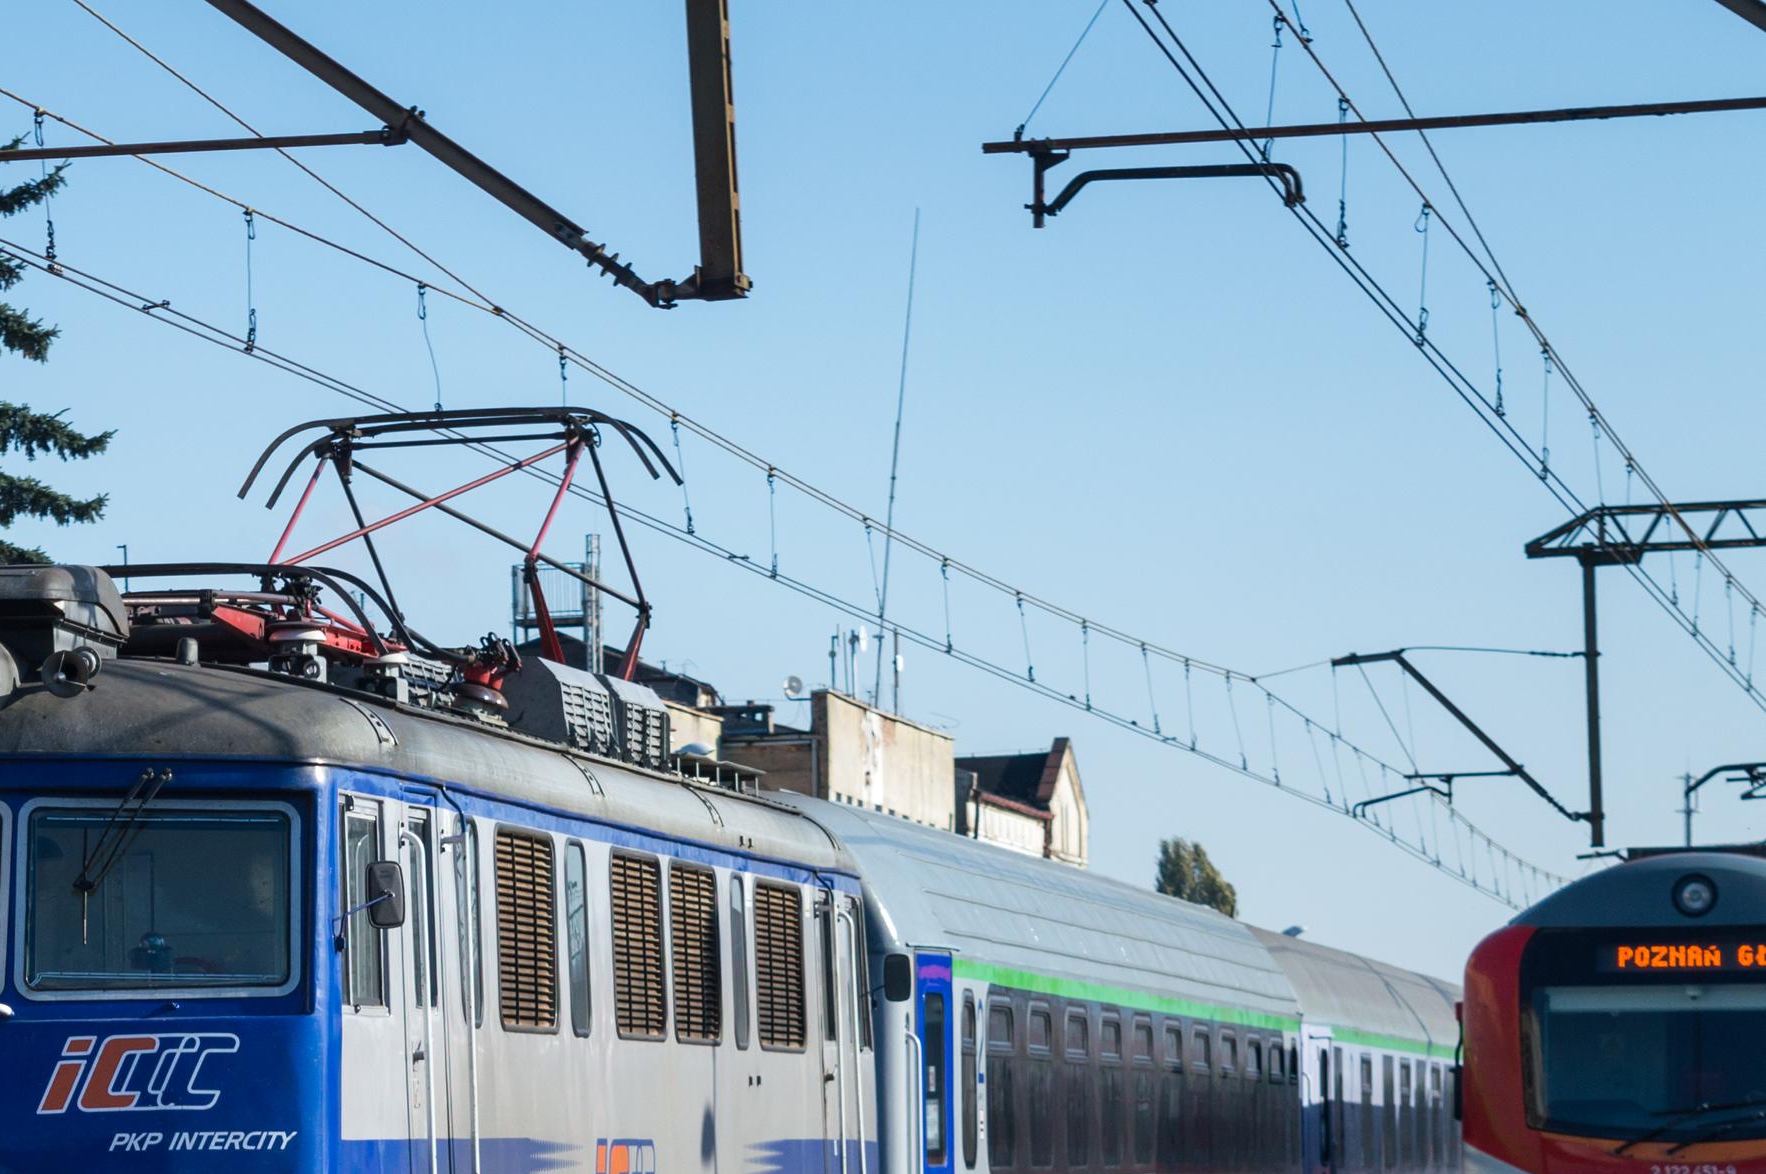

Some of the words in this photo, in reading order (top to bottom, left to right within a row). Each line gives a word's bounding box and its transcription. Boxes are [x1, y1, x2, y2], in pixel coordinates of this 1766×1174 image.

[1617, 944, 1722, 968] POZNAŃ
[108, 1131, 164, 1152] PKP
[168, 1130, 298, 1151] INTERCITY
